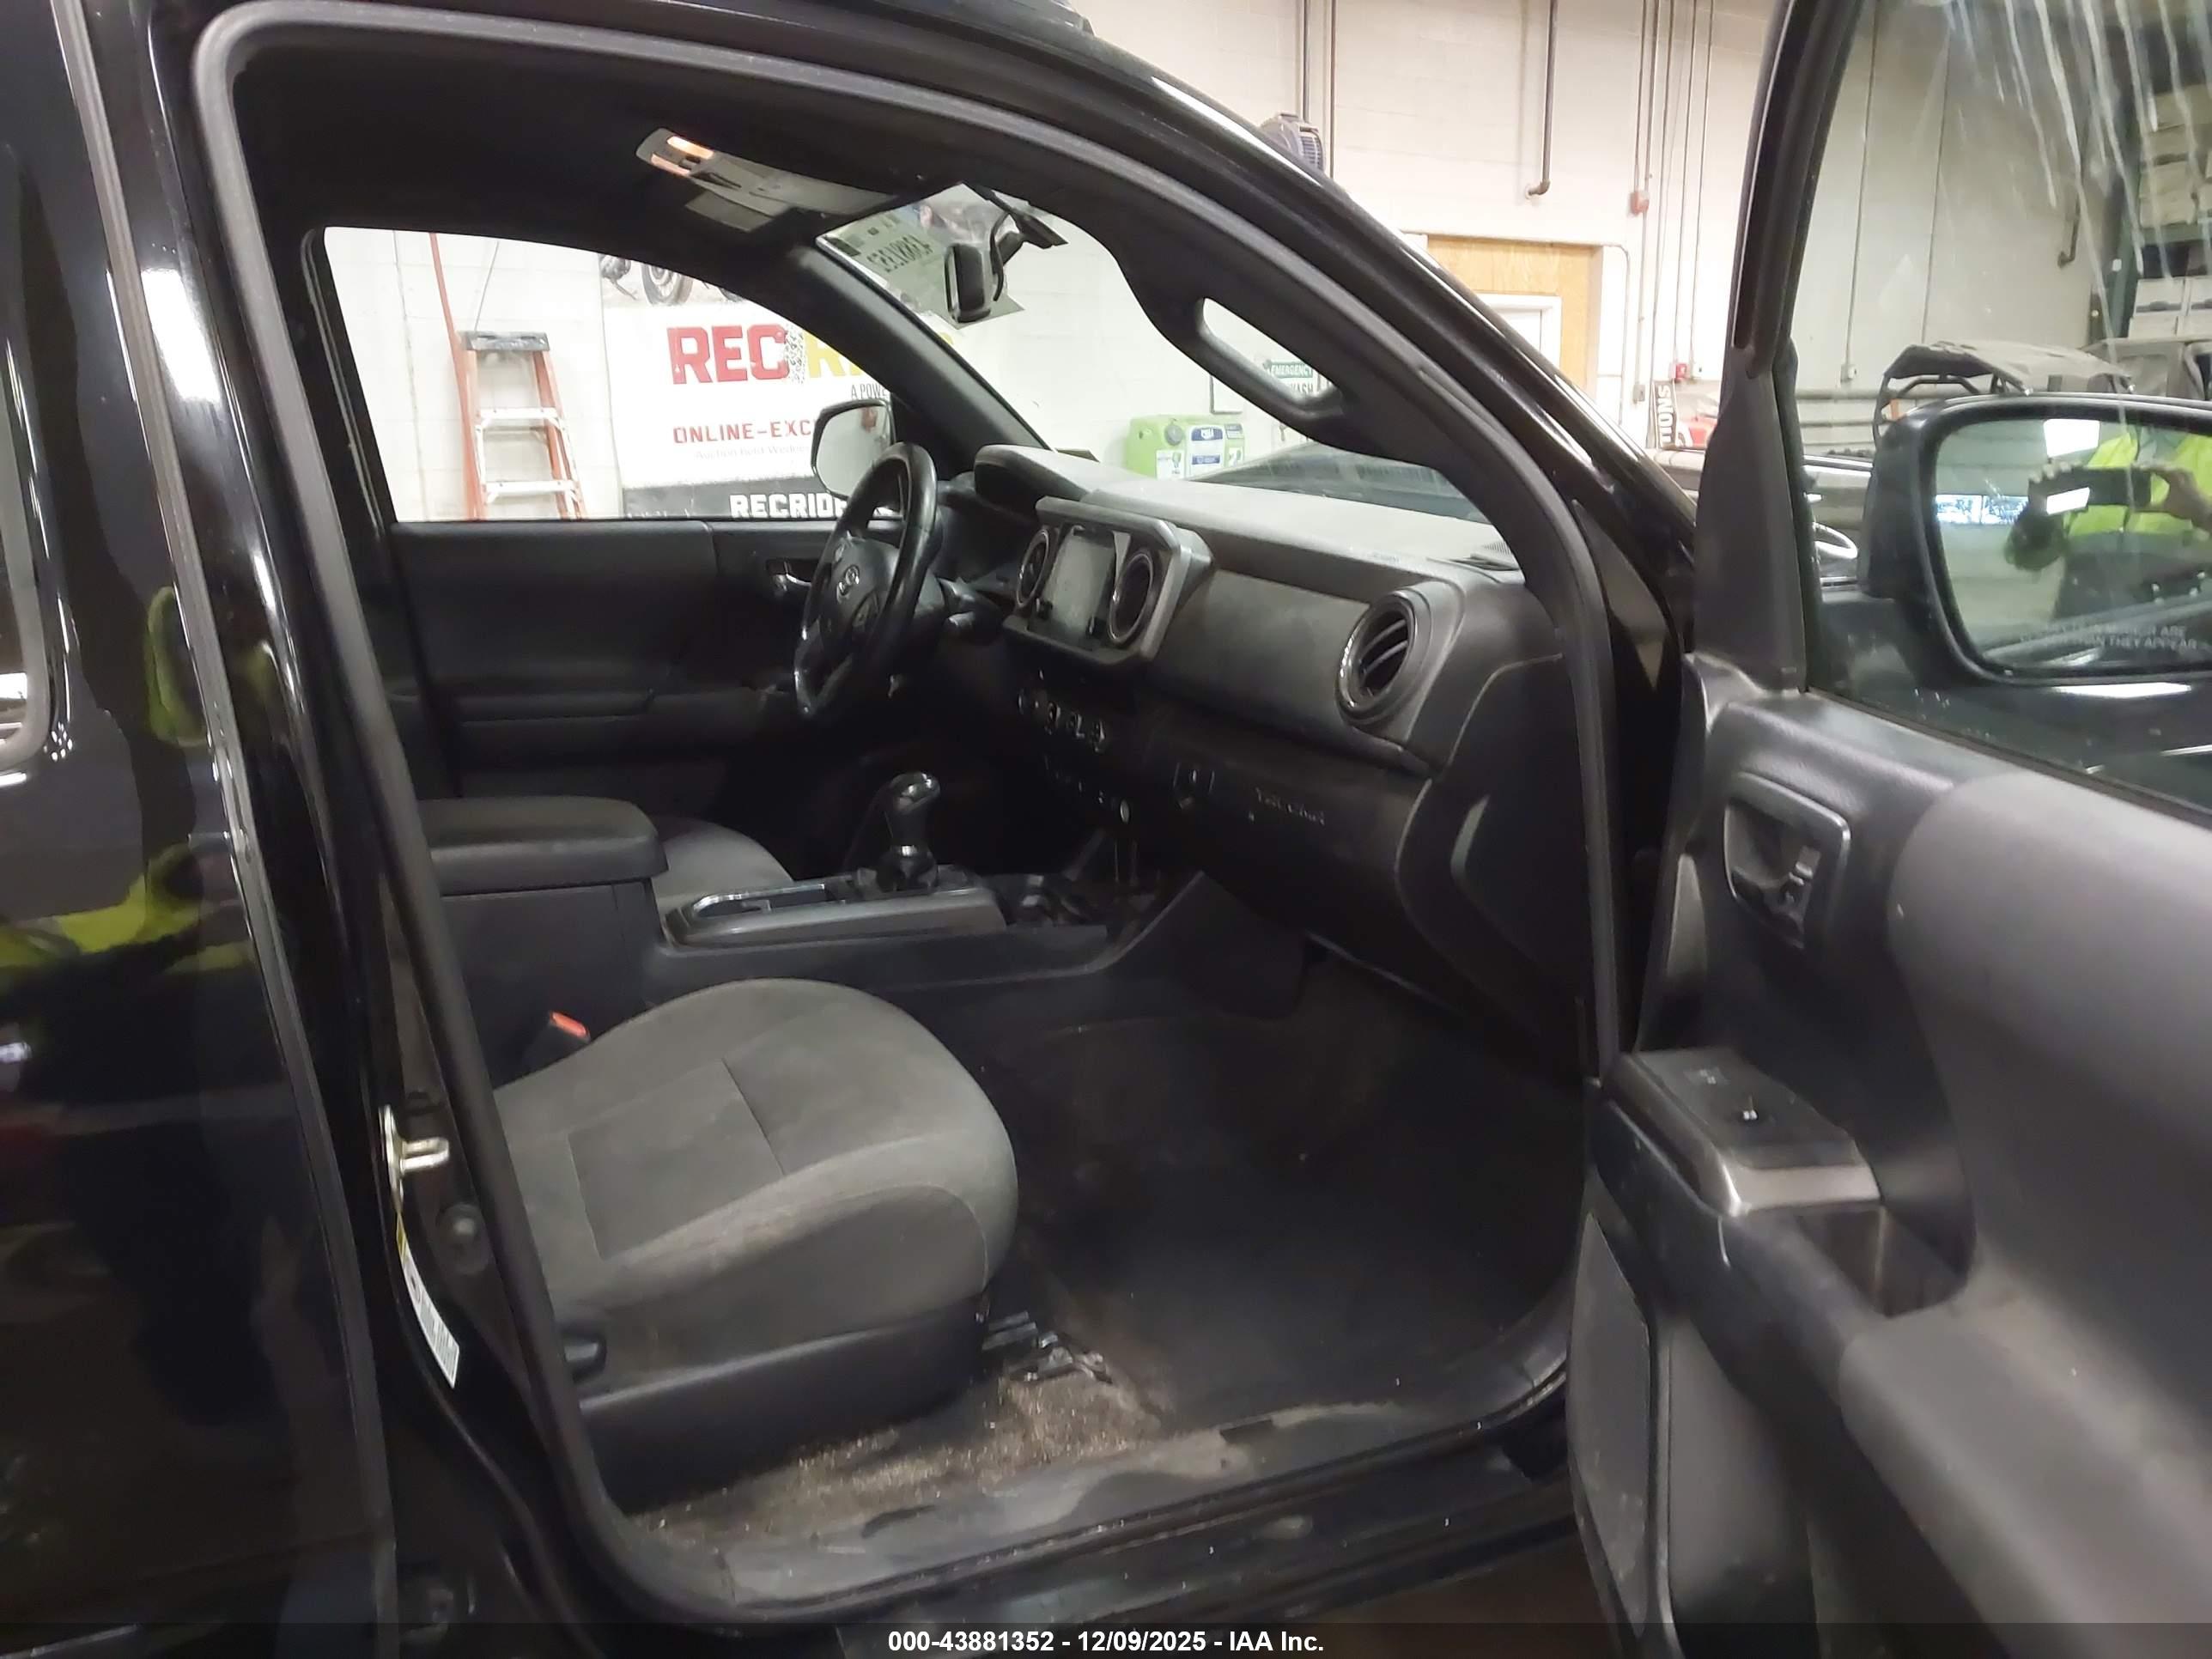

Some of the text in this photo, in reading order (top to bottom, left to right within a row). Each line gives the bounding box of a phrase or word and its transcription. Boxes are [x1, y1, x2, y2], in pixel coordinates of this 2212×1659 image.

[666, 324, 862, 385] REC R
[673, 419, 817, 444] ONLINE-EXC
